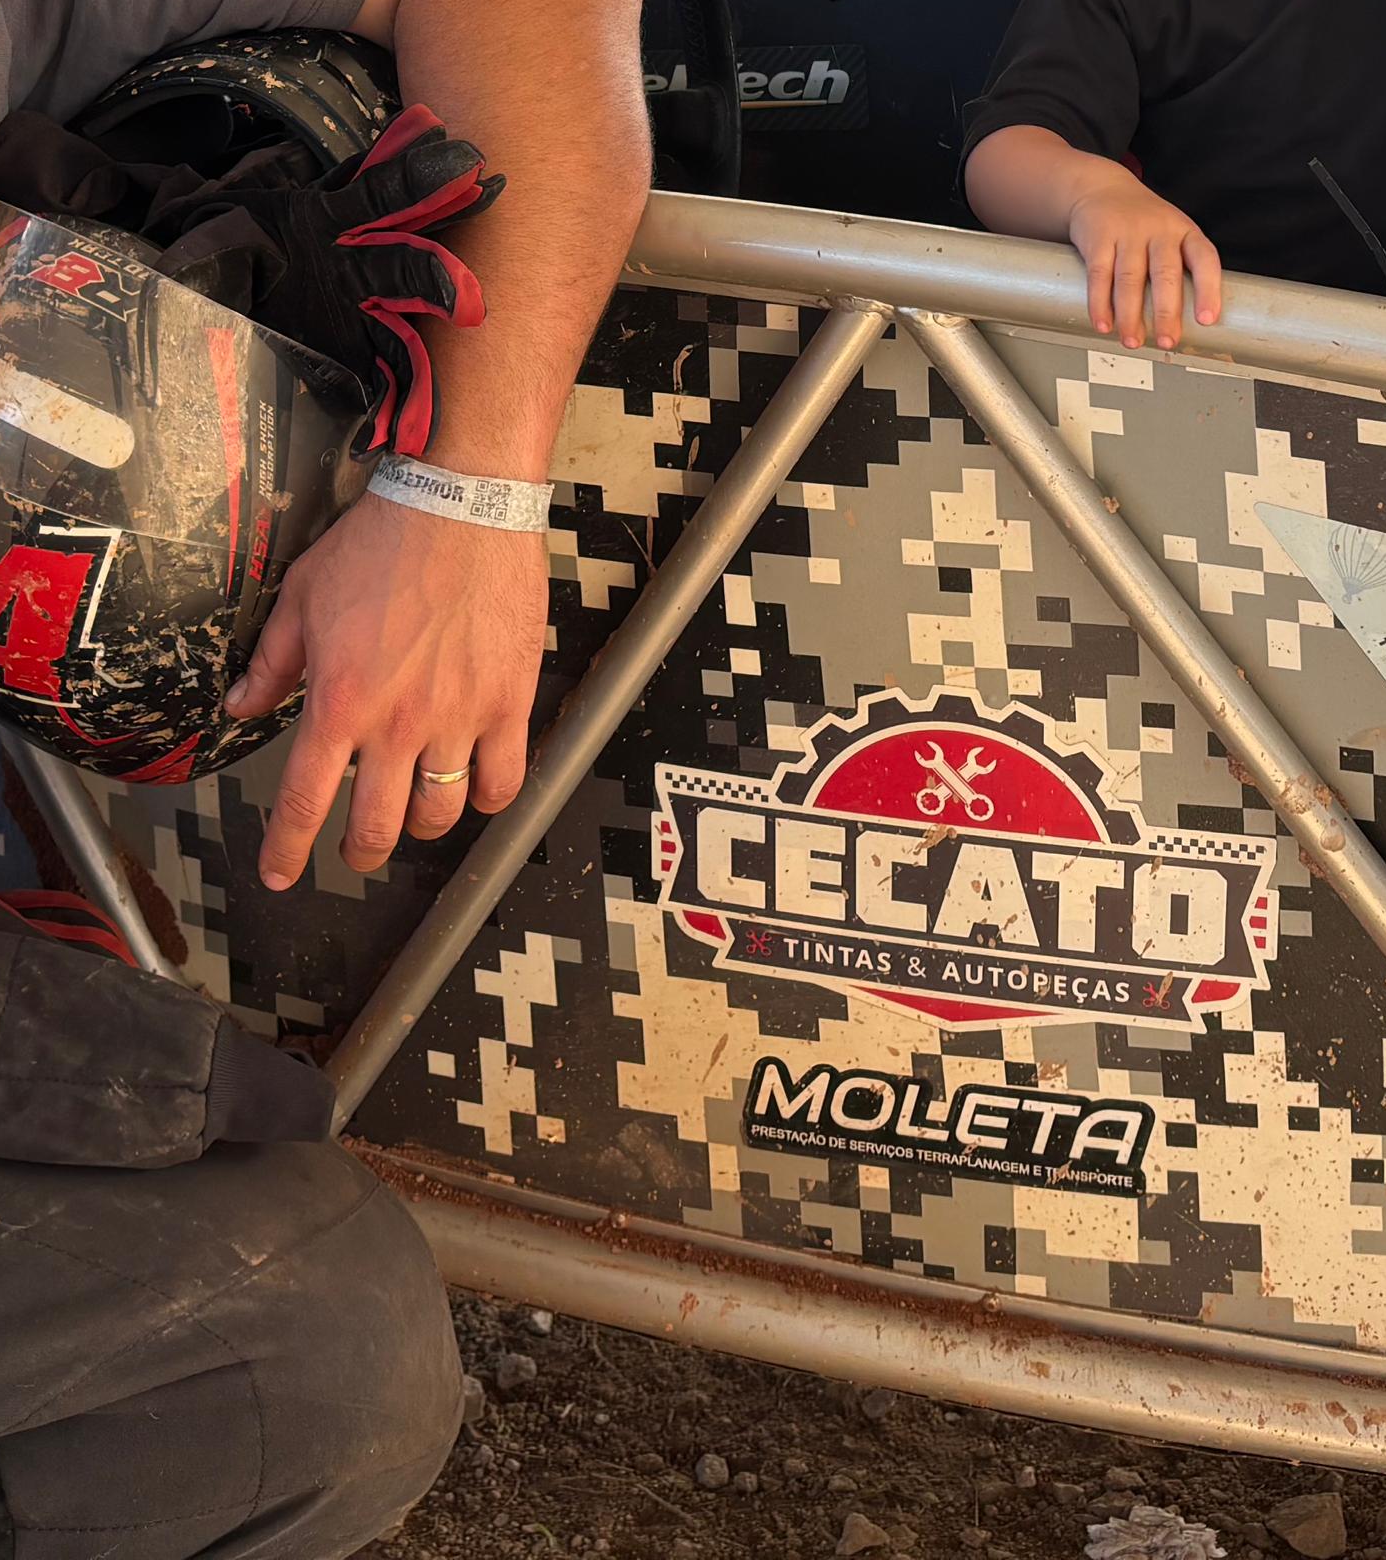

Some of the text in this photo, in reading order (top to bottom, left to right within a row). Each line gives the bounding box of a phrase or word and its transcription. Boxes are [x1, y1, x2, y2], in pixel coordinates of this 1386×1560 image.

[696, 806, 1228, 966] CECATO
[783, 938, 1131, 1004] TINTAS & AUTOPEÇAS
[751, 1124, 827, 1146] PRESTAÇÃO
[828, 1136, 847, 1150] DE
[849, 1140, 914, 1159] SERVIÇOS
[916, 1148, 1030, 1176] TERRAPLANAGEM
[1033, 1165, 1042, 1177] E
[754, 1064, 1143, 1164] MOLETA
